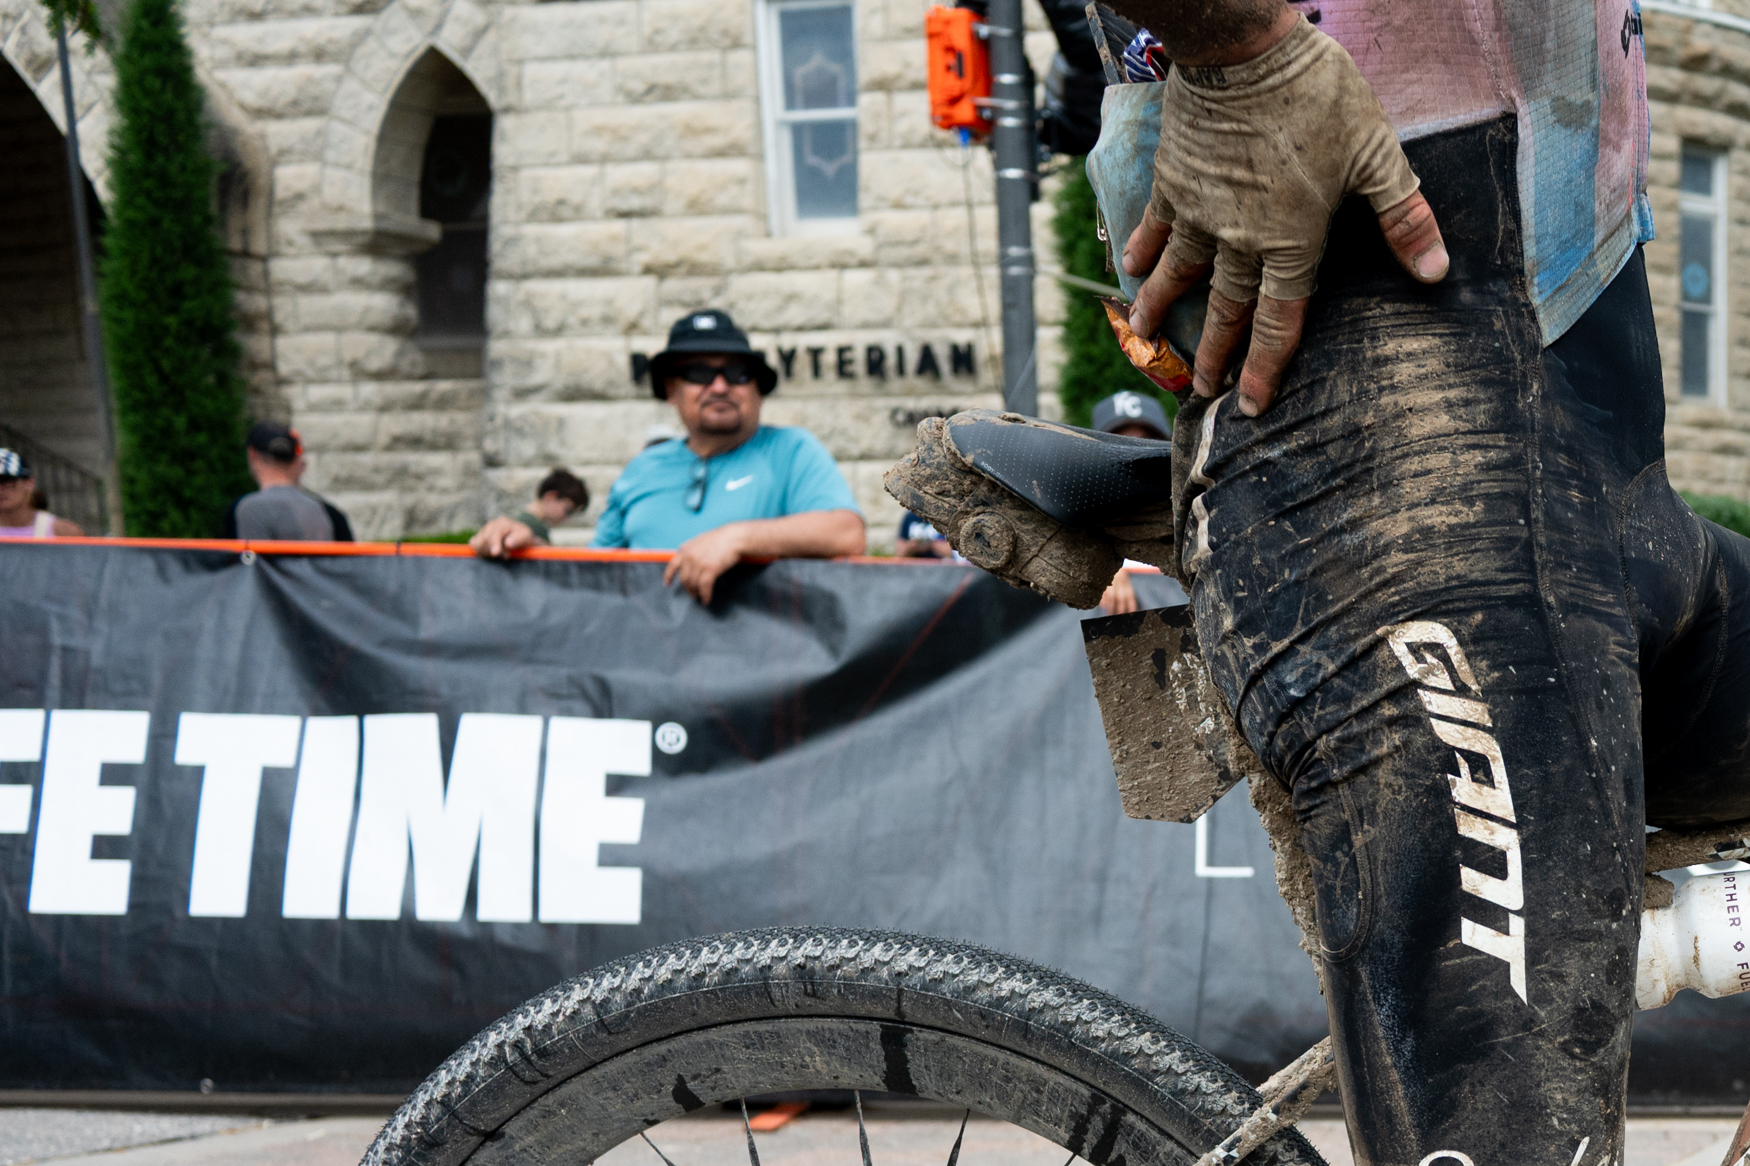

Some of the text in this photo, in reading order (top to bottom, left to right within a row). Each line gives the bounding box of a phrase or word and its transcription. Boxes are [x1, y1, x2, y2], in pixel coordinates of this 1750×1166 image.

[629, 341, 977, 387] PYTERIAN
[1376, 621, 1528, 1005] GIANT
[1723, 872, 1742, 927] URTHER
